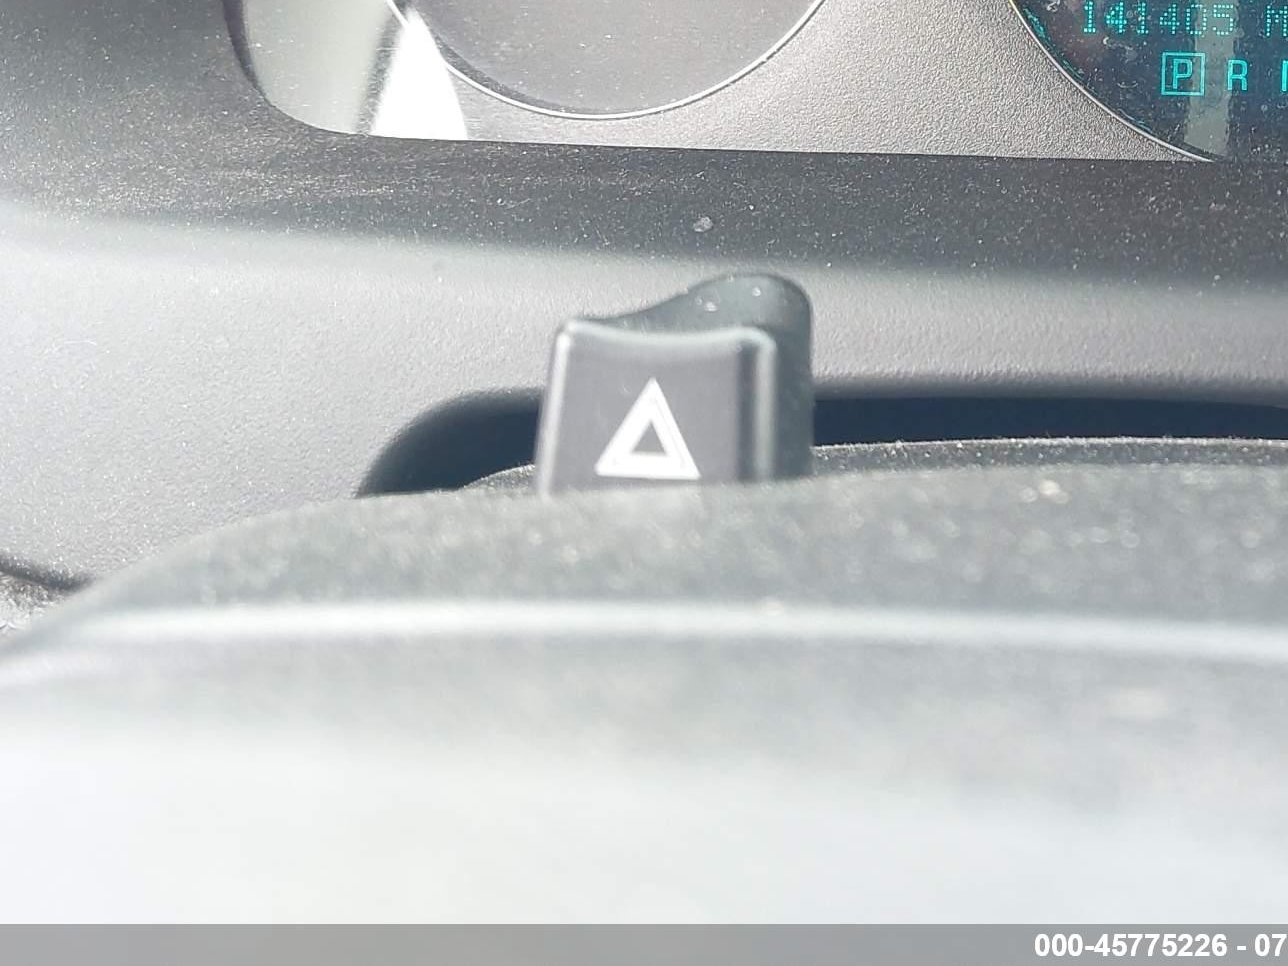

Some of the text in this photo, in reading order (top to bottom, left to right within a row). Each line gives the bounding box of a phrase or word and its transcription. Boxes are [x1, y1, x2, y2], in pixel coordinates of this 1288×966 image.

[1082, 1, 1236, 36] 141405
[1172, 58, 1193, 90] P
[1227, 59, 1249, 91] R
